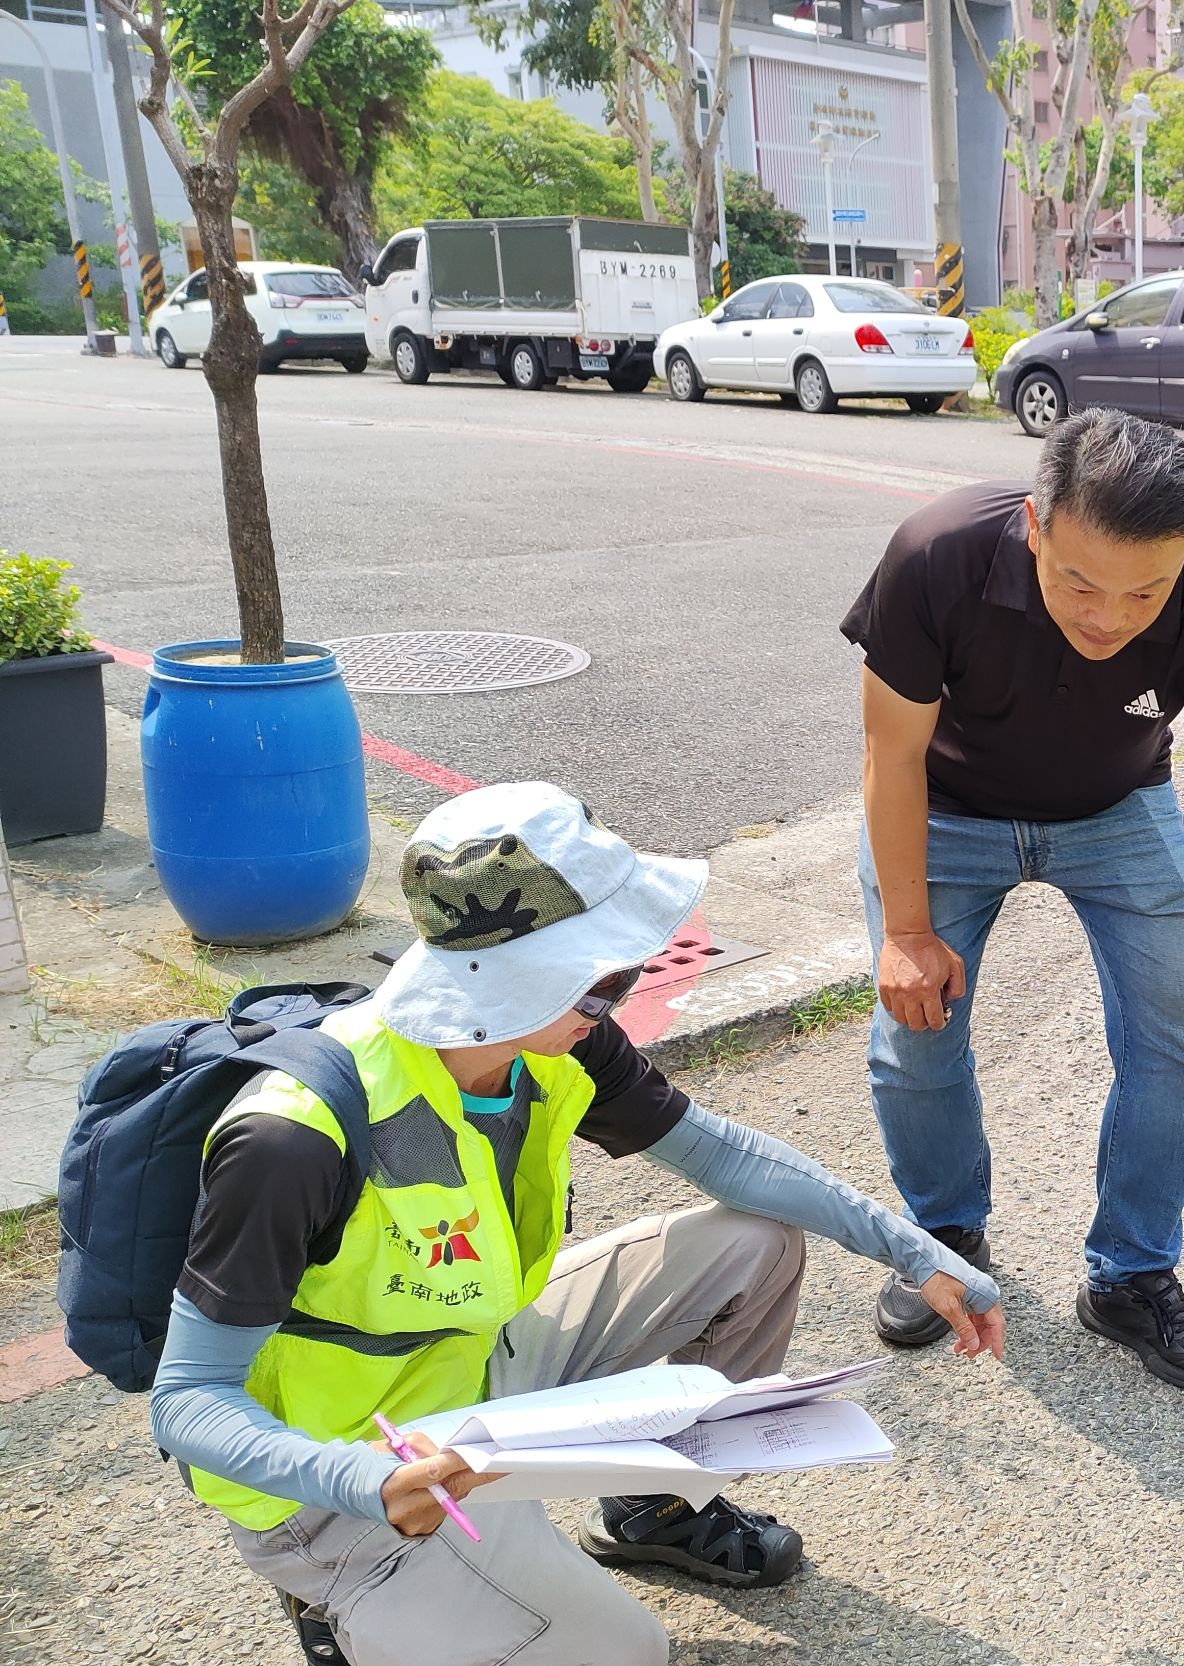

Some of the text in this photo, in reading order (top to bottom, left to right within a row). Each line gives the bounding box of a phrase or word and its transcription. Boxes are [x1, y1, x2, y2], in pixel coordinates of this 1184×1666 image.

[599, 260, 677, 279] BYM-2269
[1124, 704, 1165, 719] adidas
[382, 1273, 484, 1306] 臺南地政
